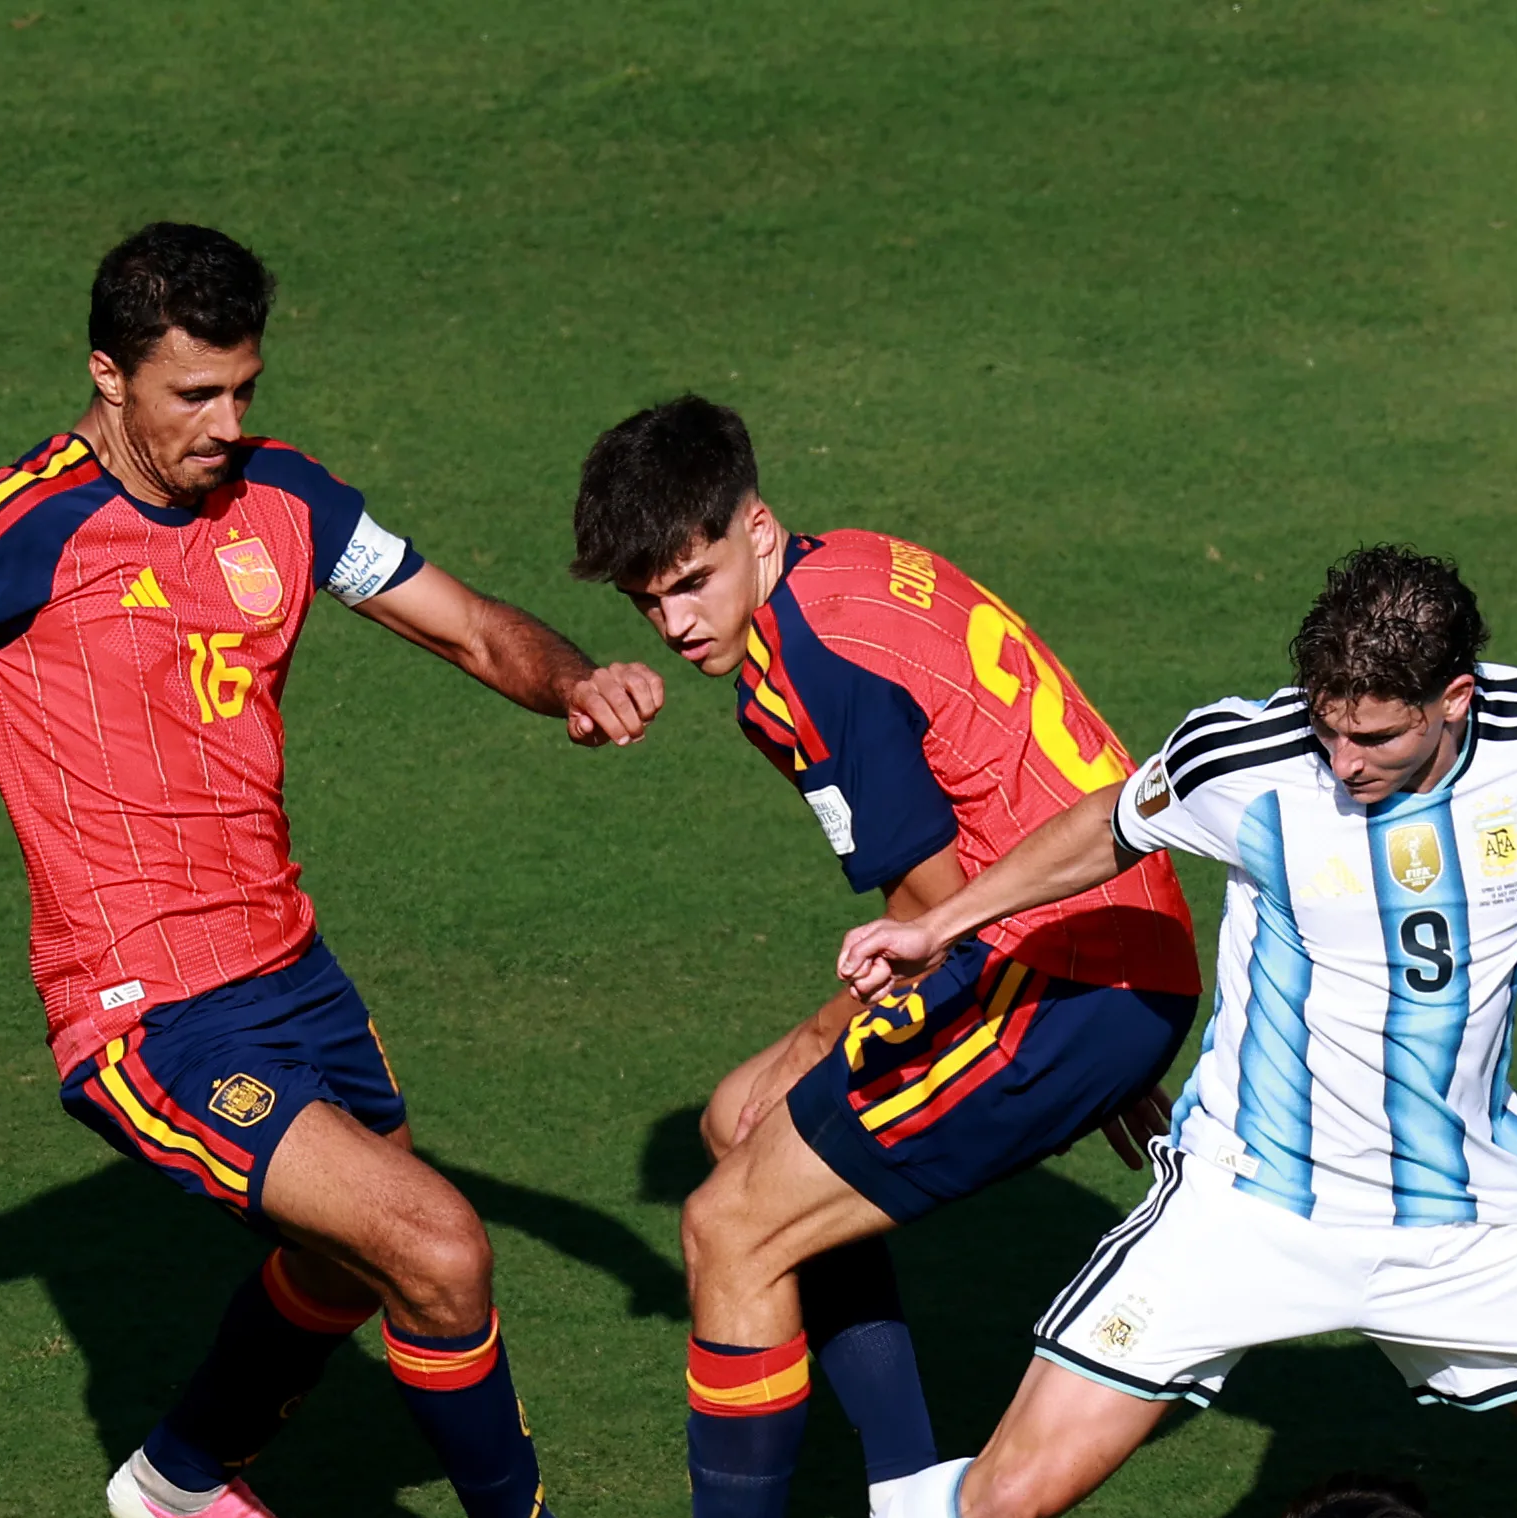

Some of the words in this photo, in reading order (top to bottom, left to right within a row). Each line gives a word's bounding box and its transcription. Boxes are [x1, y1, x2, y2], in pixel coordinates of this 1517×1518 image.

[328, 539, 366, 583] NITES
[345, 546, 383, 586] World
[187, 632, 253, 724] 16
[967, 580, 1128, 794] 2
[1485, 828, 1516, 858] AFA
[1400, 910, 1454, 994] 9
